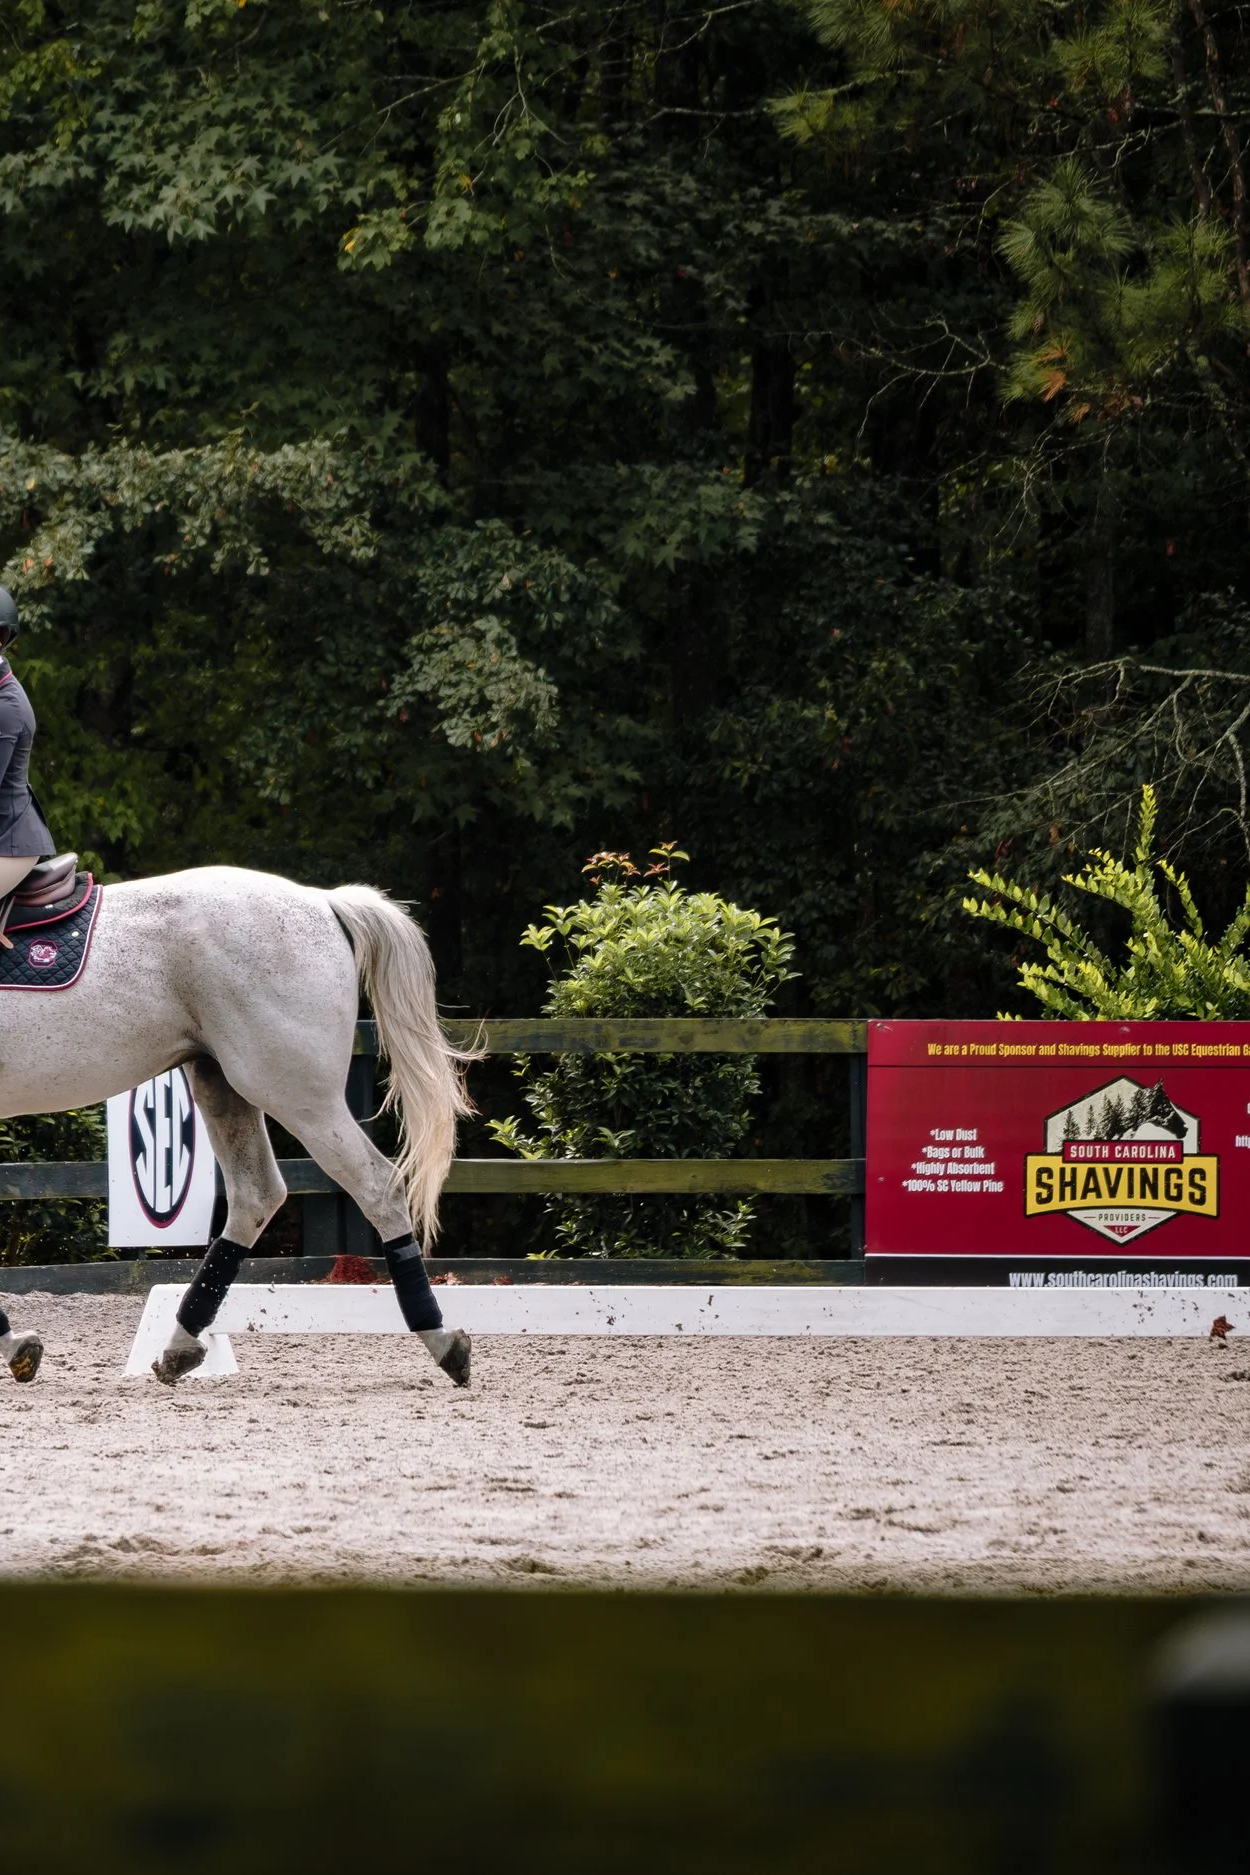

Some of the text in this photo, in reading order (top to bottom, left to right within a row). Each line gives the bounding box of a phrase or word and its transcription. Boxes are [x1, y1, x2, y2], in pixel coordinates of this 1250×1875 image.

[927, 1043, 942, 1056] We
[944, 1045, 959, 1056] are
[961, 1045, 968, 1056] a
[969, 1043, 996, 1056] Proud
[998, 1043, 1036, 1057] Sponsor
[1038, 1043, 1056, 1056] and
[1058, 1043, 1100, 1057] Shavings
[1102, 1043, 1142, 1058] Supplier
[1142, 1044, 1153, 1056] to
[1155, 1043, 1170, 1056] the
[1172, 1044, 1189, 1056] USC
[1191, 1043, 1241, 1058] Equestrian
[133, 1066, 191, 1214] SEC
[956, 1128, 978, 1141] Dust
[951, 1147, 963, 1158] or
[963, 1146, 985, 1158] Bulk
[1070, 1145, 1176, 1159] SOUTH CAROLINA
[947, 1162, 996, 1175] Absorbent
[937, 1180, 949, 1192] SC
[950, 1180, 981, 1192] Yellow
[983, 1179, 1004, 1192] Pine
[1035, 1167, 1207, 1206] SHAVINGS
[1098, 1213, 1146, 1222] PROVIDERS
[1114, 1226, 1128, 1234] LLC
[1009, 1270, 1238, 1287] www.southcarolinashavings.com
